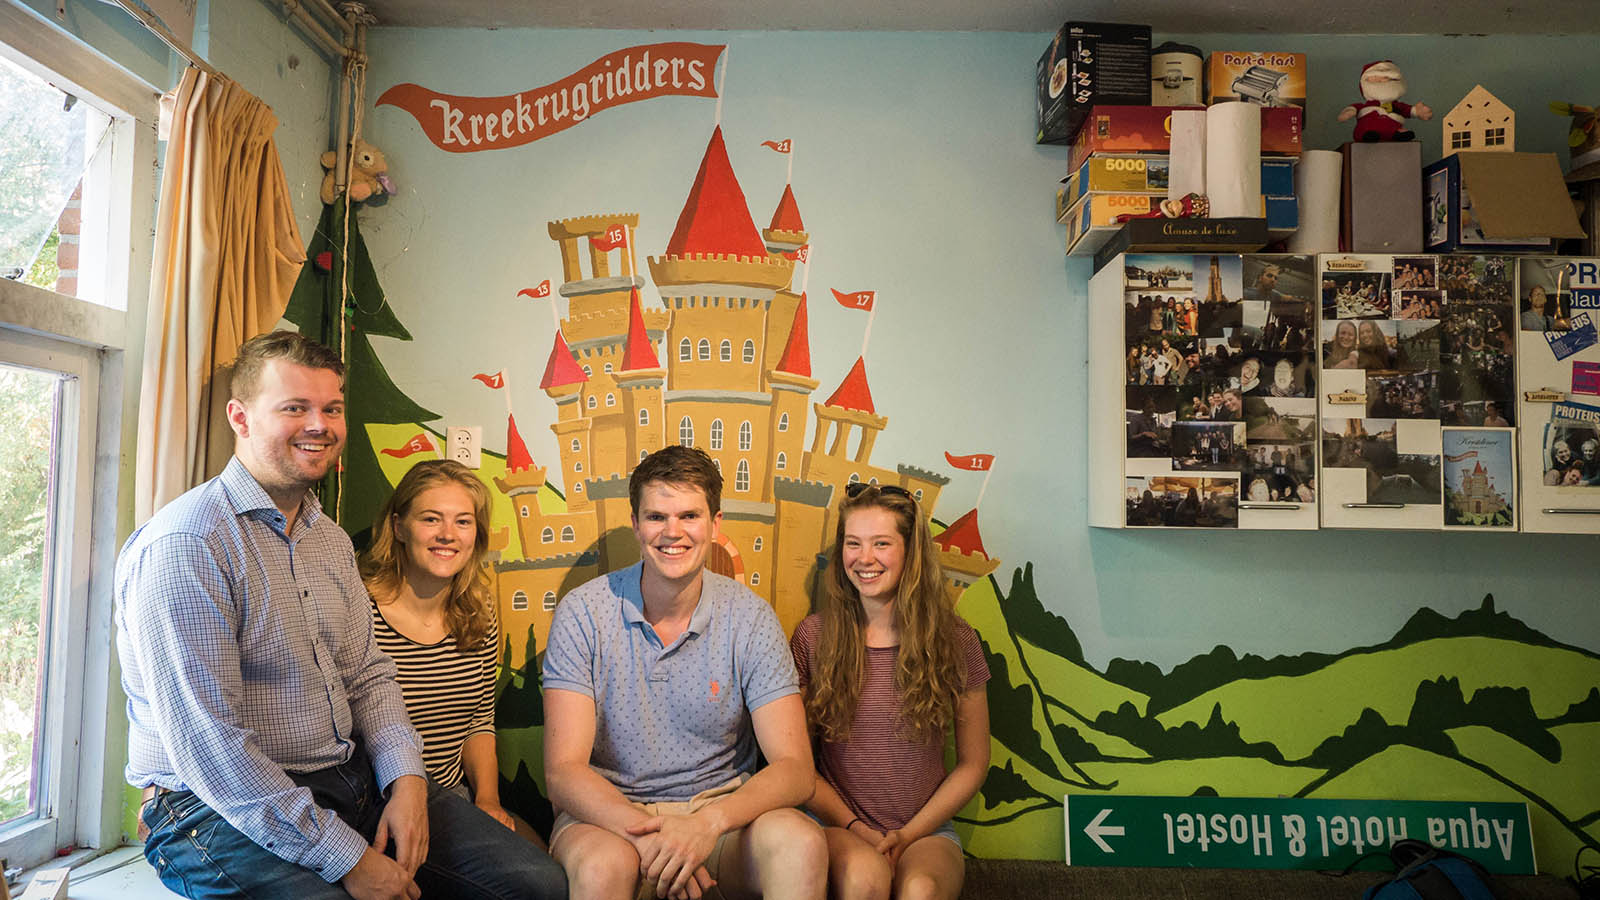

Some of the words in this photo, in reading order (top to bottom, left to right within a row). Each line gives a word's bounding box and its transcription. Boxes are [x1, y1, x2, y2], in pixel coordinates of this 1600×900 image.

[777, 142, 789, 152] 21
[1105, 158, 1146, 171] 5000
[1108, 196, 1149, 207] 5000
[609, 229, 622, 244] 15
[797, 249, 808, 261] 19
[537, 284, 549, 296] 13
[856, 294, 870, 306] 17
[490, 375, 500, 387] 7
[1555, 405, 1600, 424] PROTEUS
[410, 439, 422, 452] 5
[970, 457, 984, 469] 11
[1163, 812, 1274, 856] Hostel
[1282, 814, 1307, 857] &
[1426, 807, 1514, 861] Aqua
